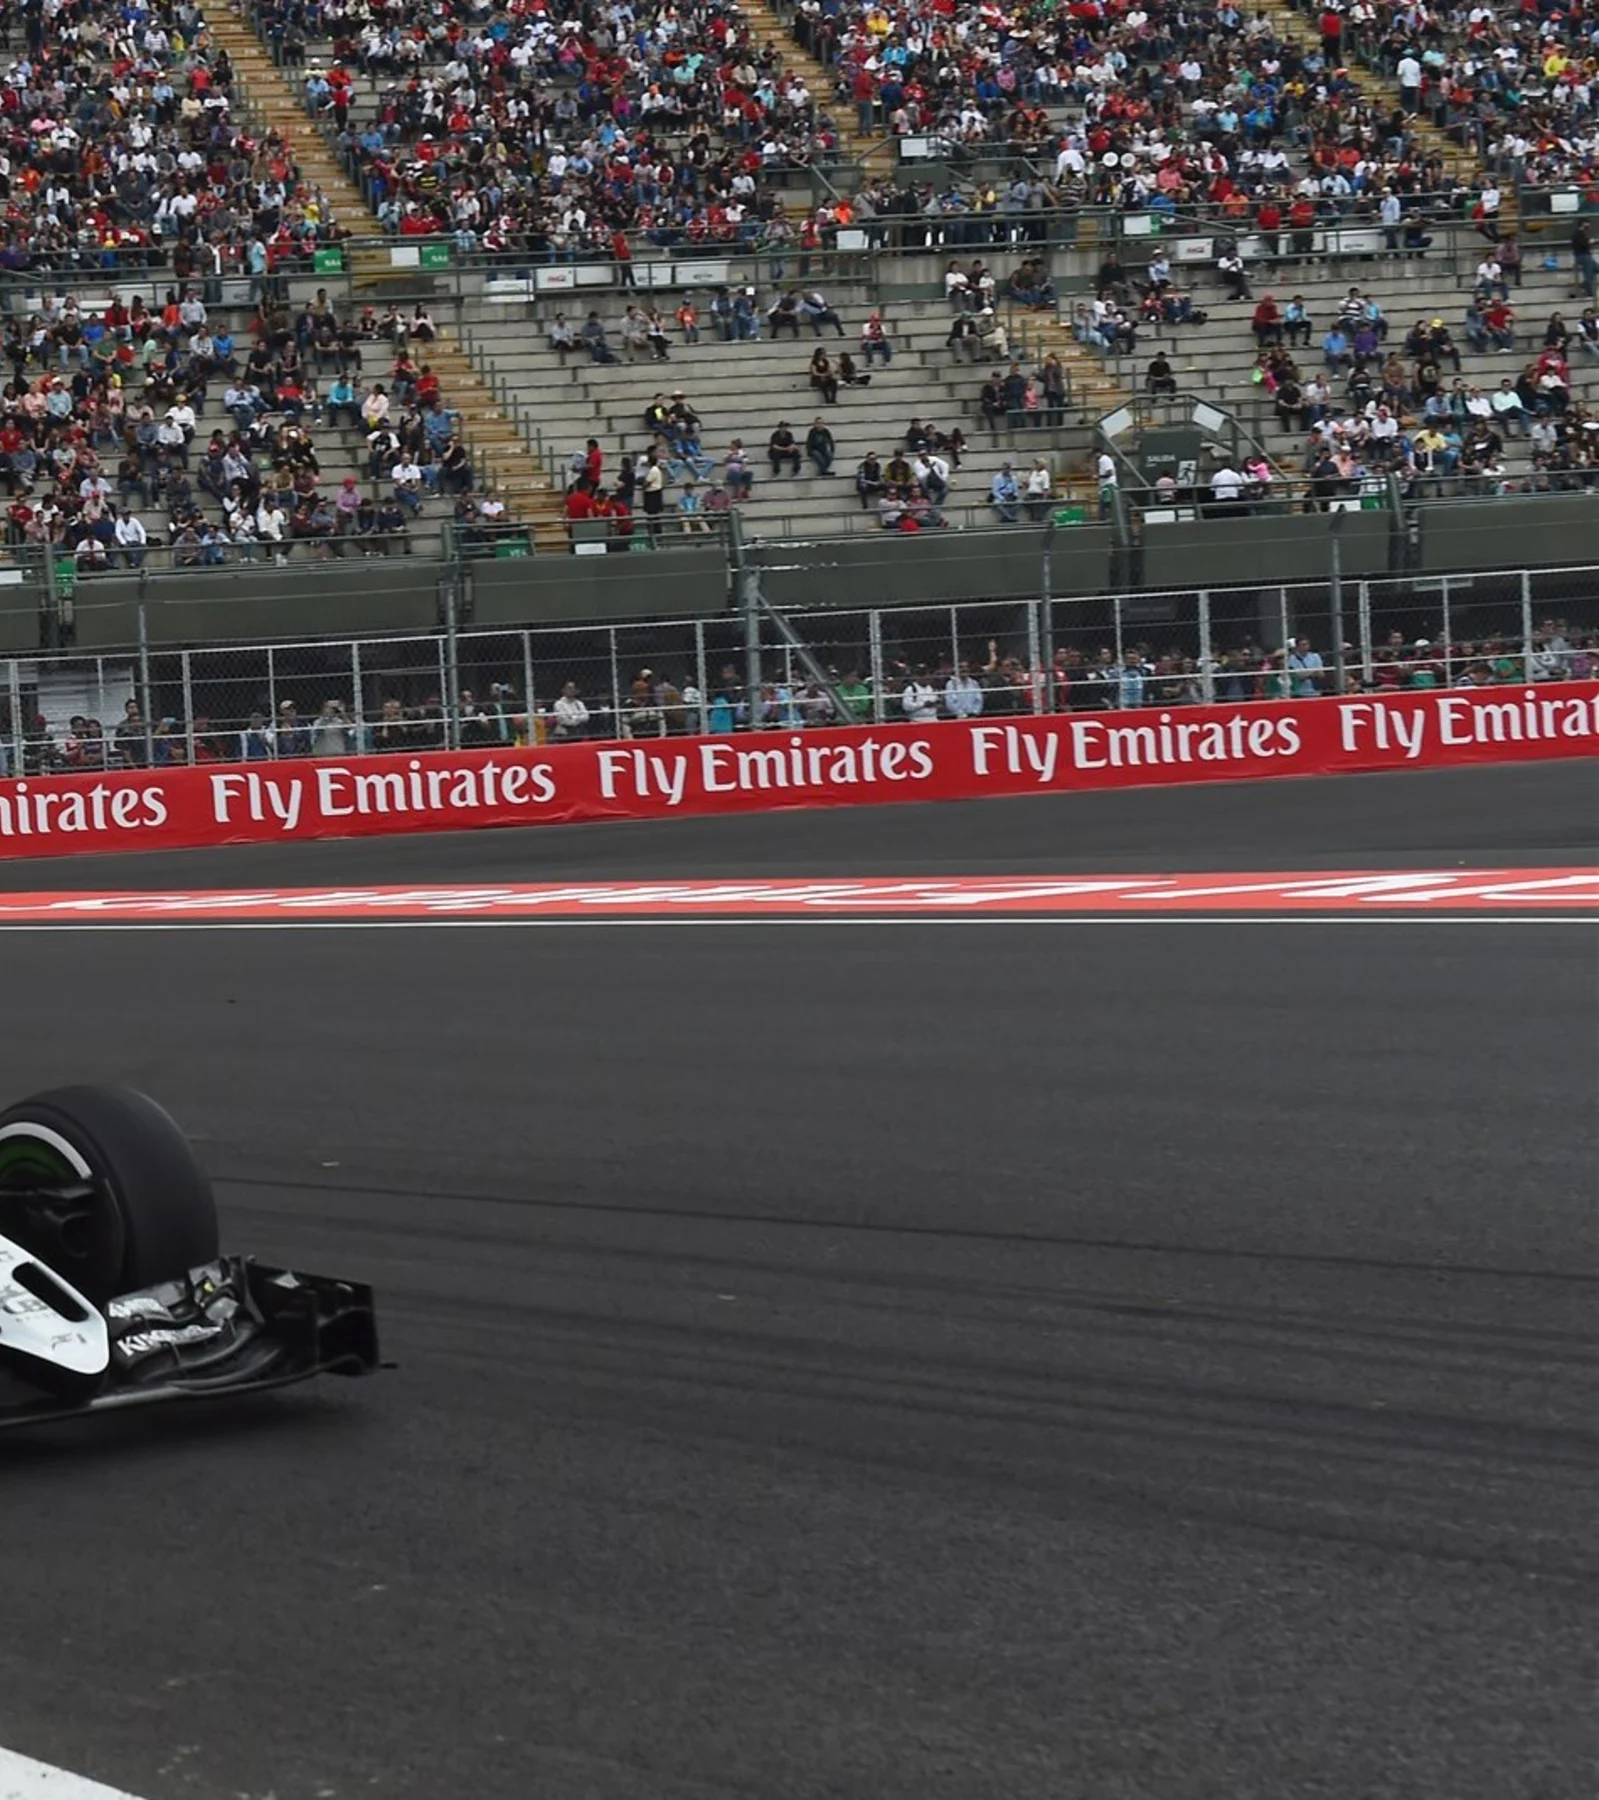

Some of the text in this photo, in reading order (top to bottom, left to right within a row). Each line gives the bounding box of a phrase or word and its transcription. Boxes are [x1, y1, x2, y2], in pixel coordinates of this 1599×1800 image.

[971, 714, 1300, 782] Fly Emirates
[1339, 704, 1423, 758] Fly
[211, 761, 555, 830] Fly Emirates
[598, 737, 933, 805] Fly Emirates
